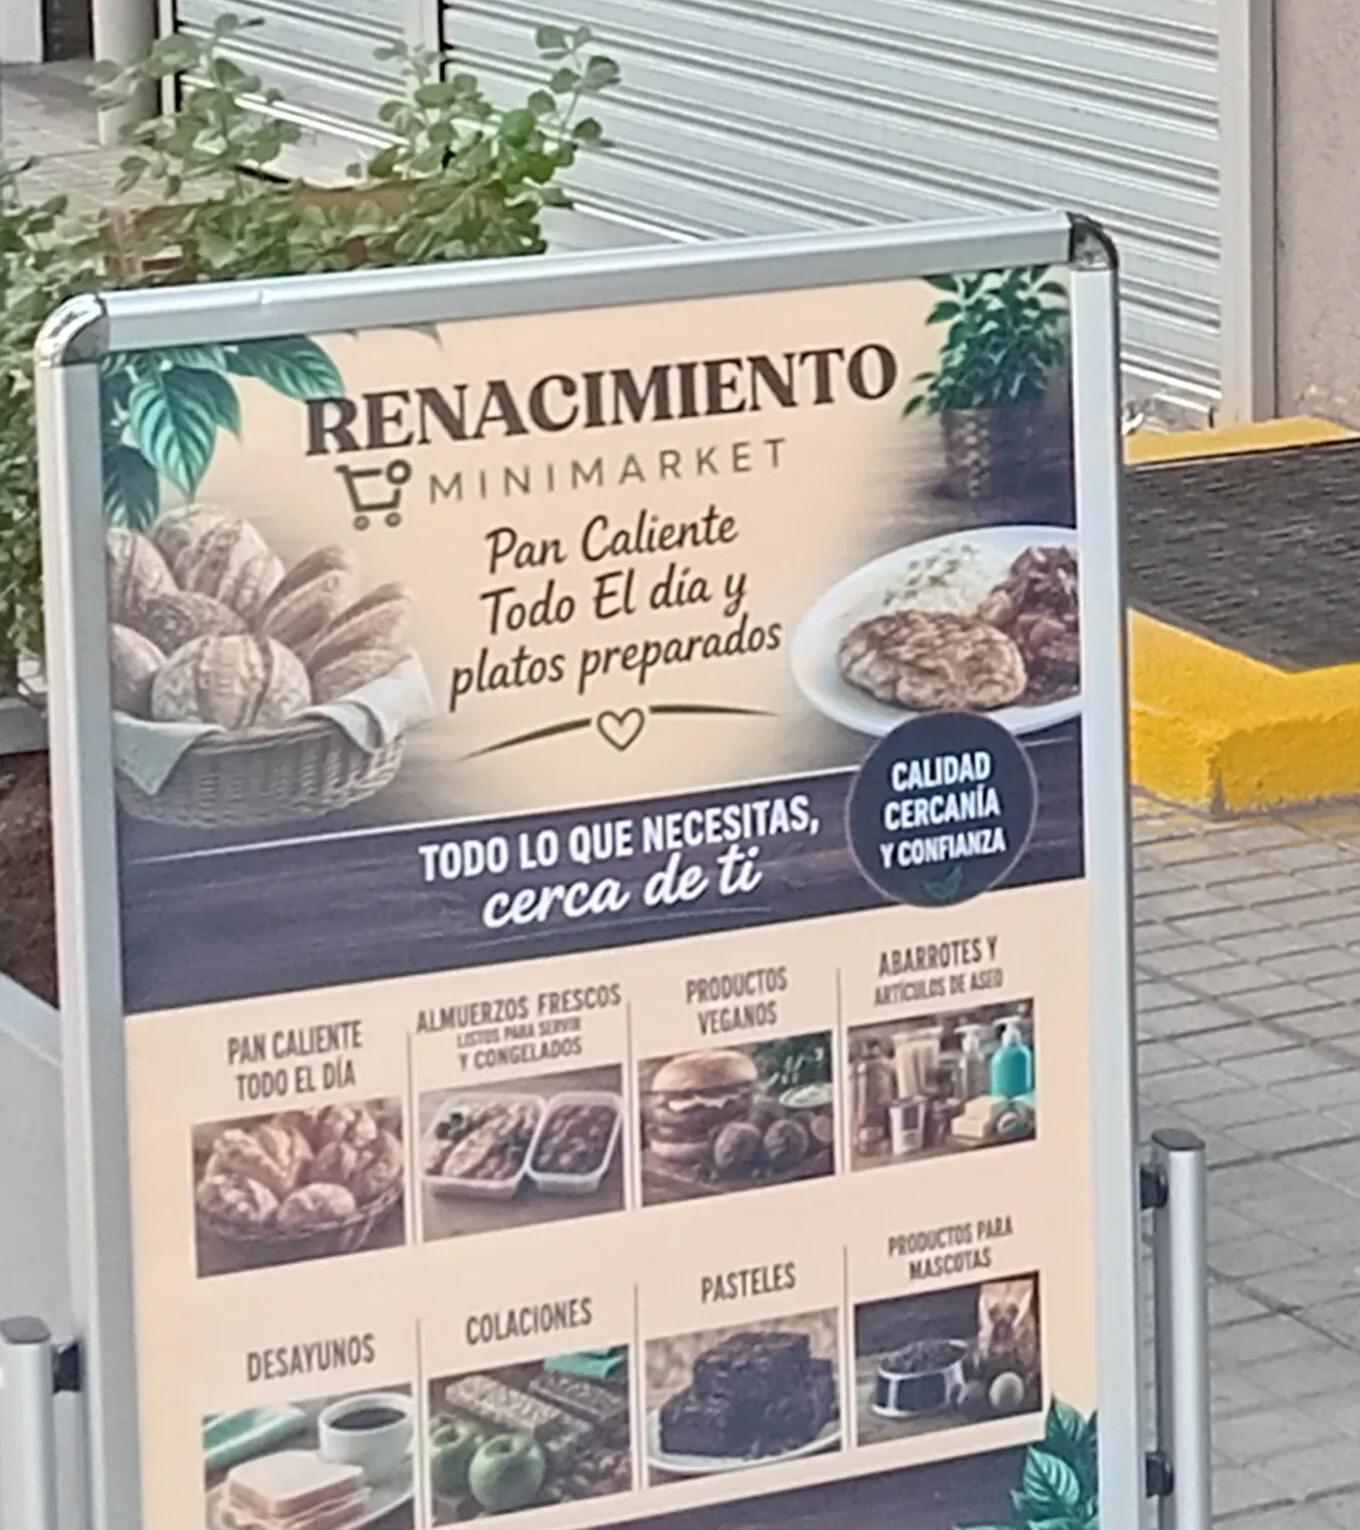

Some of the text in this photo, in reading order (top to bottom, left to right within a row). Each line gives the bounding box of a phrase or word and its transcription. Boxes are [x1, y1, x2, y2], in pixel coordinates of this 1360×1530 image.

[305, 343, 897, 456] RENACIMIENTO
[429, 437, 786, 504] MINIMARKET
[485, 504, 739, 574] Pan Caliente
[480, 562, 747, 635] Todo El día y
[450, 611, 783, 713] platos preparados
[891, 751, 992, 792] CALIDAD
[884, 783, 1001, 831] CERCANÍA
[419, 795, 820, 882] TODO LO QUE NECESITAS,
[880, 826, 1007, 869] Y CONFIANZA
[482, 843, 764, 929] cerca de ti
[879, 935, 998, 977] ABARROTES Y
[686, 966, 788, 1004] PRODUCTOS
[949, 971, 965, 995] DE
[970, 967, 1004, 990] ASEO
[416, 982, 622, 1033] ALMUERZOS FRESCOS
[697, 1001, 777, 1035] VEGANOS
[228, 1019, 363, 1065] PAN CALIENTE
[459, 1037, 583, 1071] Y CONGELADOS
[236, 1055, 356, 1101] TODO EL DÍA
[888, 1215, 1014, 1257] PRODUCTOS PARA
[701, 1262, 797, 1304] PASTELES
[909, 1246, 992, 1280] MASCOTAS
[466, 1297, 593, 1345] COLACIONES
[248, 1332, 375, 1382] DESAYUNOS
